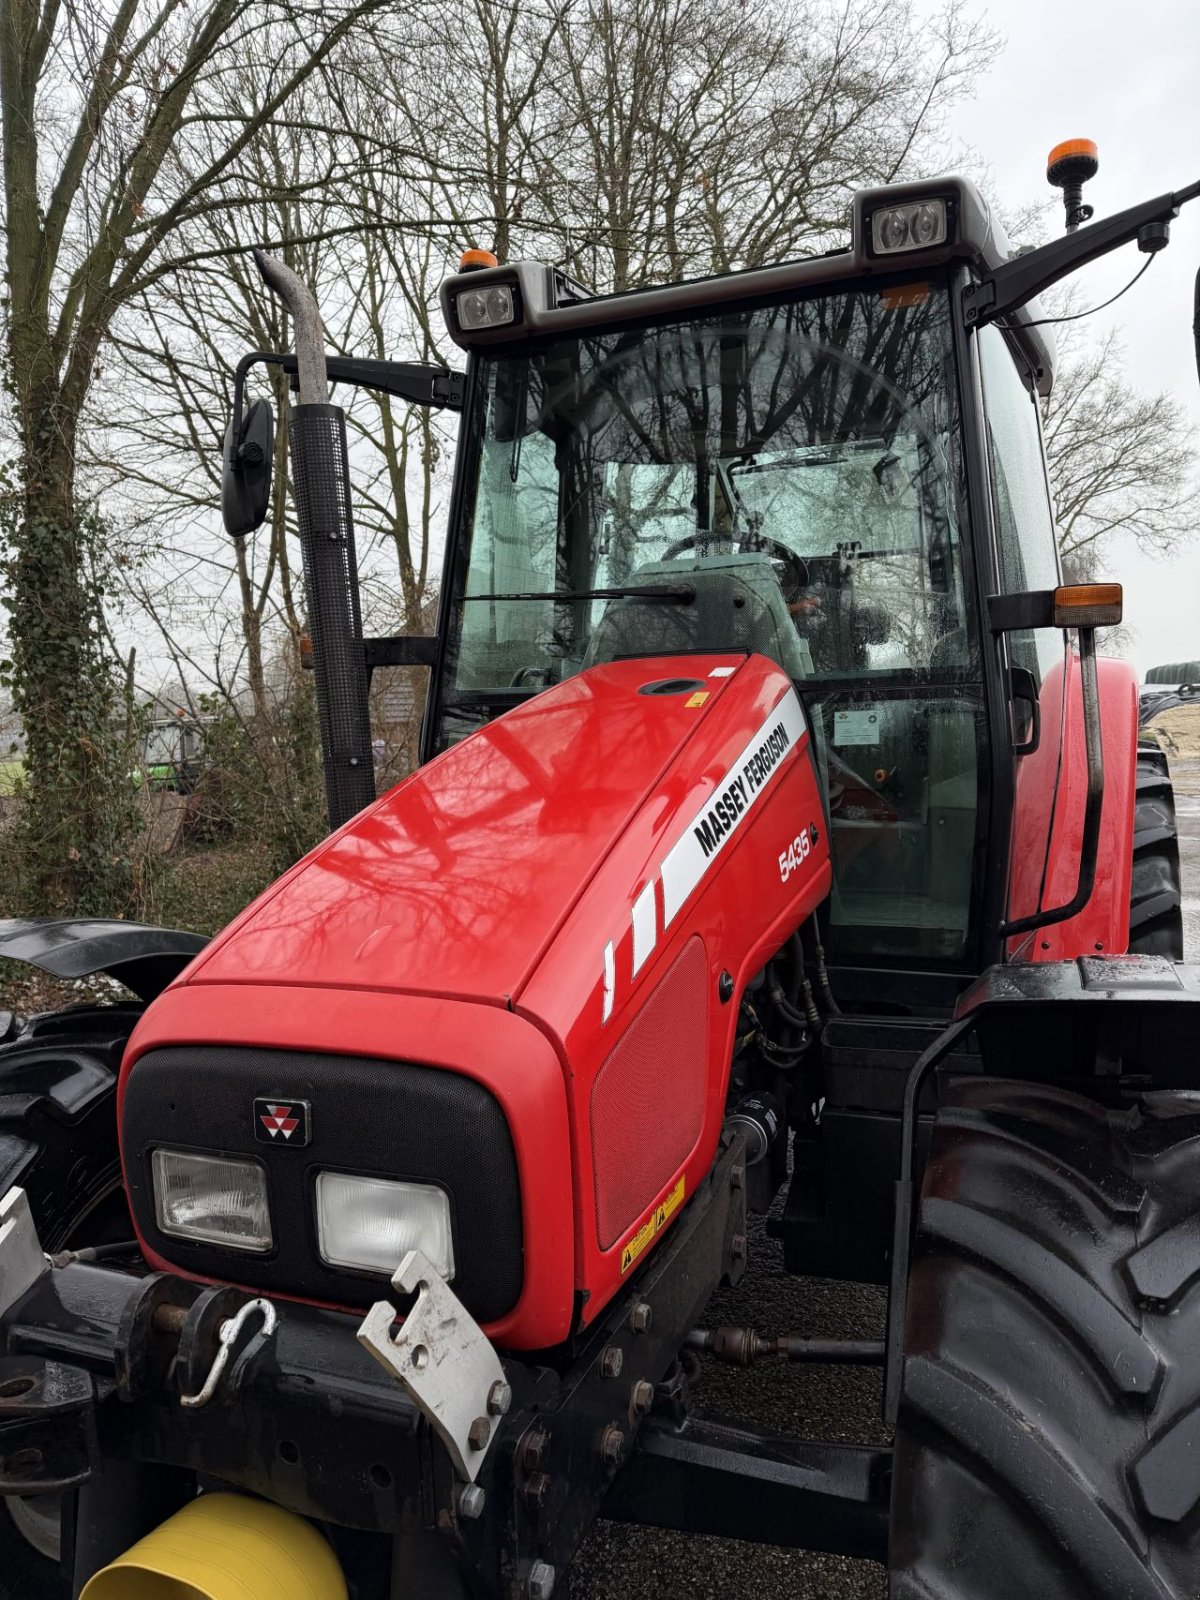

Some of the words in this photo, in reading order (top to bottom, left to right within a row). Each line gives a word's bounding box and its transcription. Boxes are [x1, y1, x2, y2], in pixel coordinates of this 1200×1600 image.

[694, 775, 749, 857] MASSEY
[743, 722, 790, 793] FERGUSON
[778, 829, 810, 882] 5435
